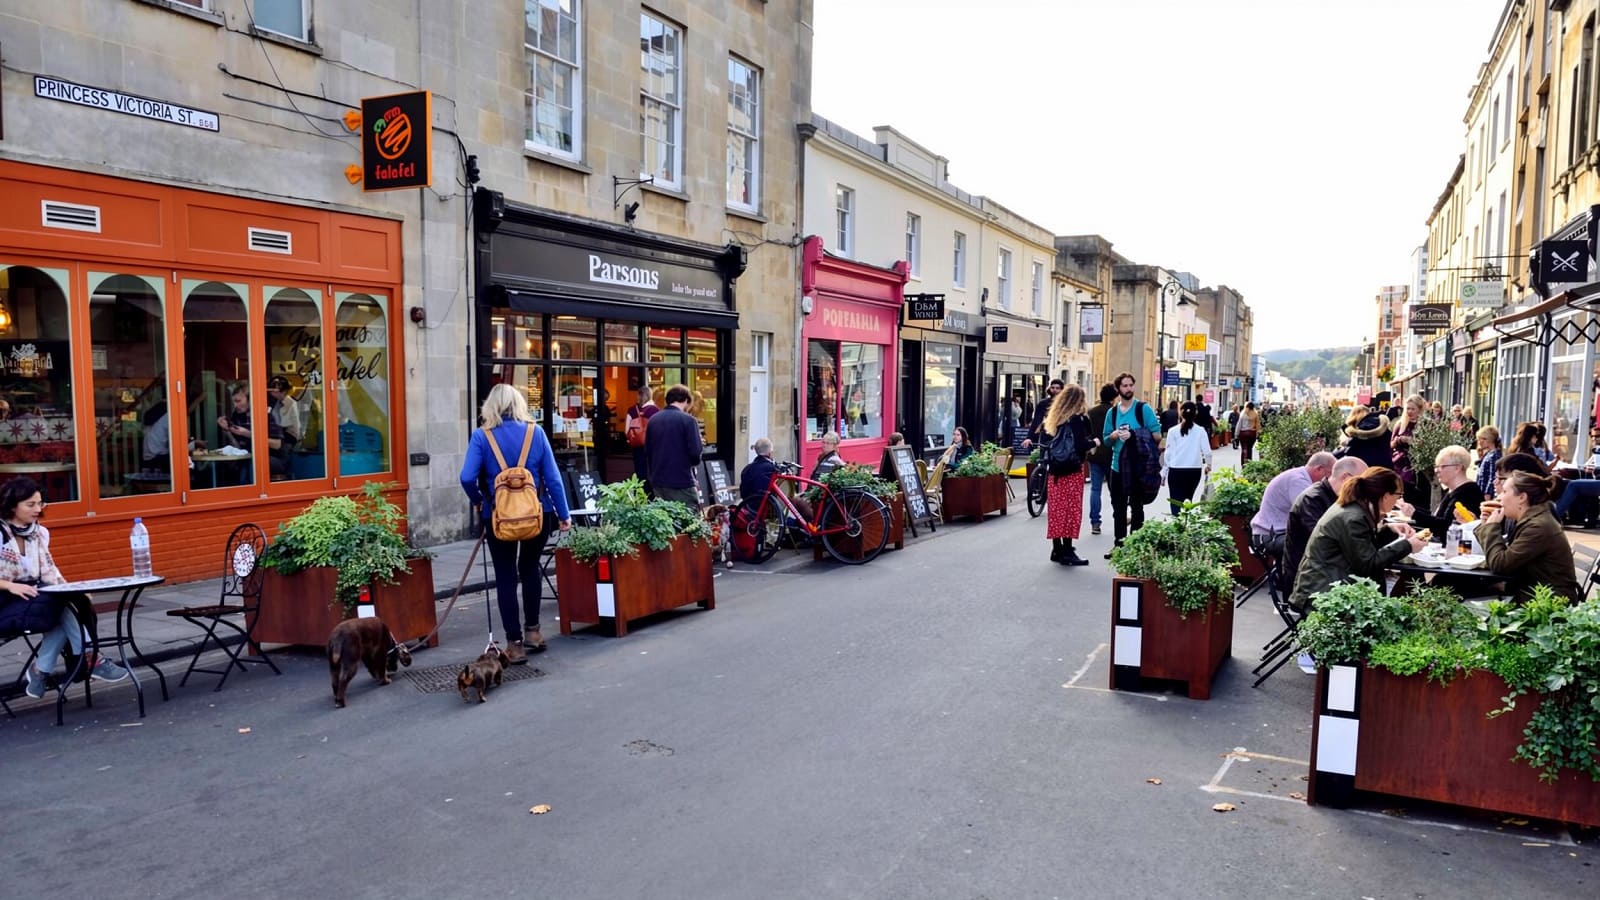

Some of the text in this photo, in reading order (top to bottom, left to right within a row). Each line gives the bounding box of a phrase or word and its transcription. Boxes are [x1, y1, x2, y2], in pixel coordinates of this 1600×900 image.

[38, 79, 109, 107] PRINCESS
[114, 94, 173, 120] VICTORIA
[375, 162, 415, 180] falafel
[589, 254, 659, 289] Parsons
